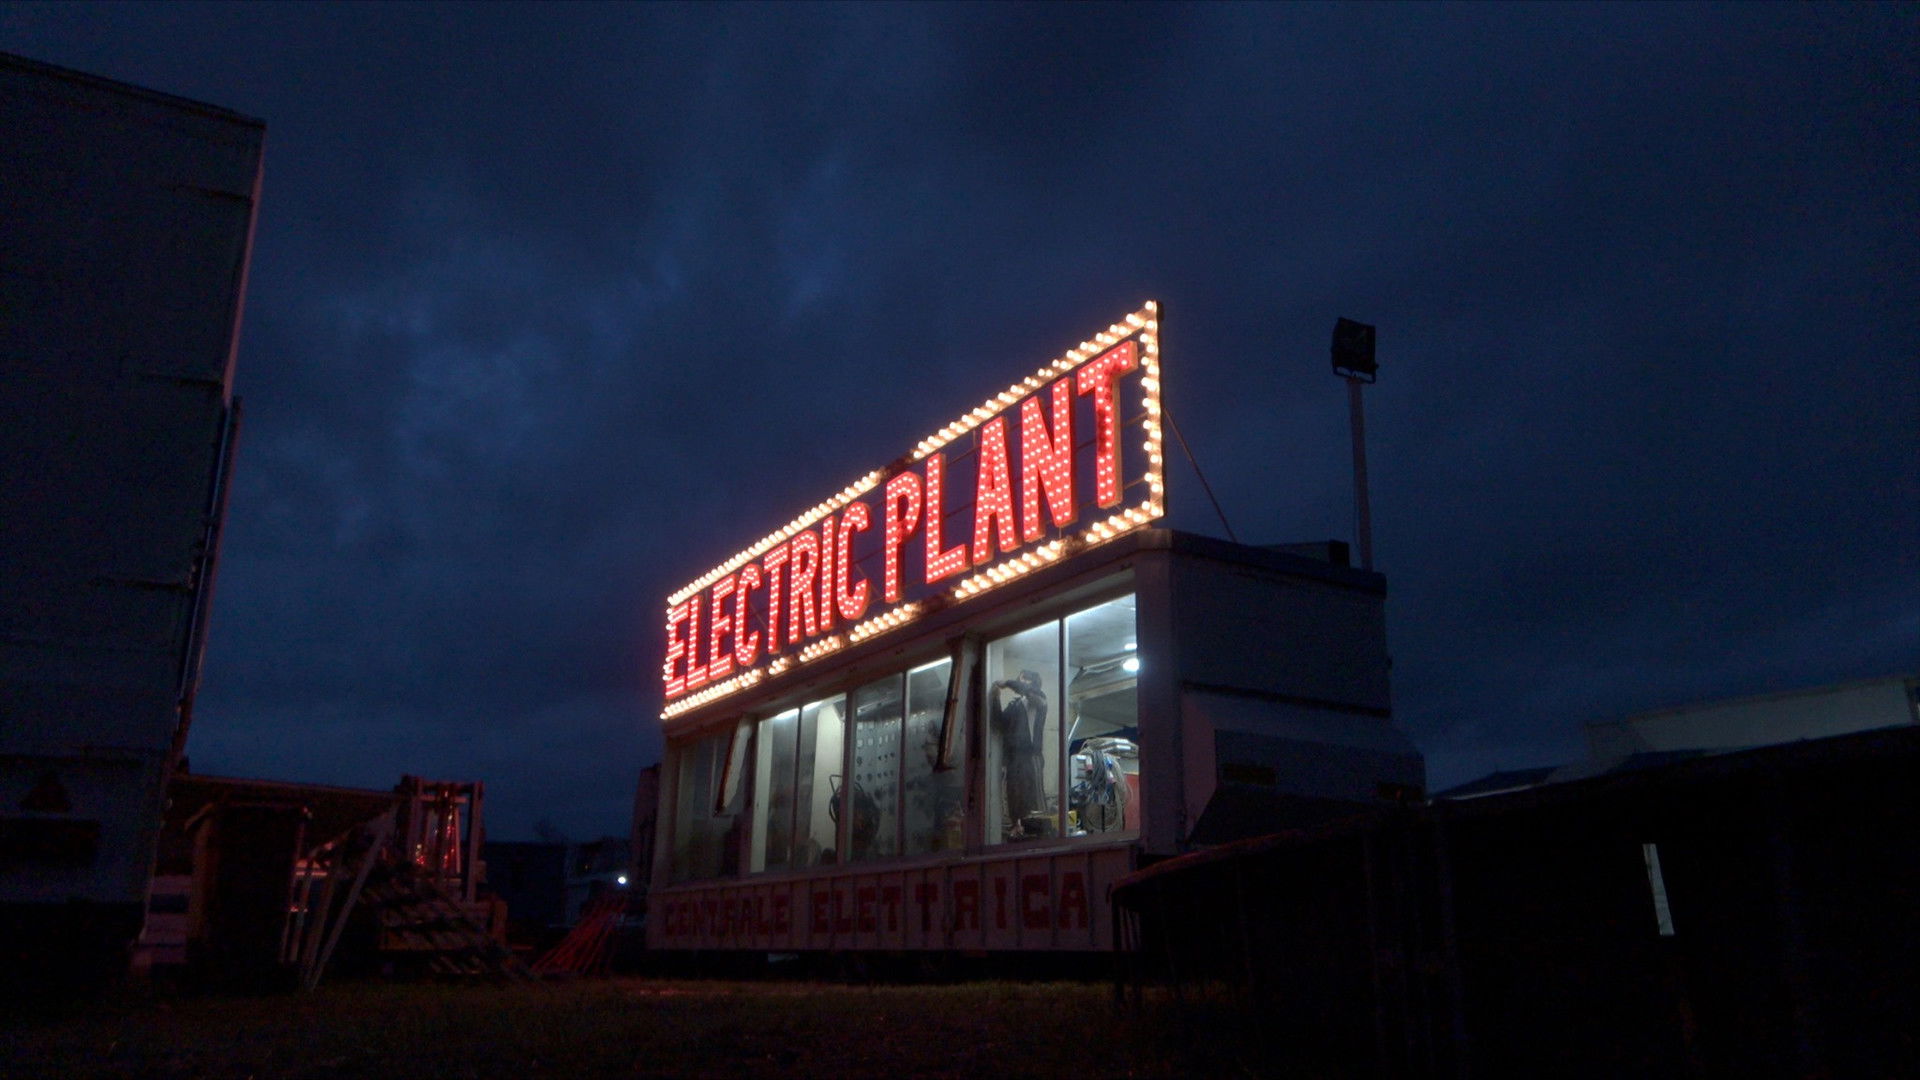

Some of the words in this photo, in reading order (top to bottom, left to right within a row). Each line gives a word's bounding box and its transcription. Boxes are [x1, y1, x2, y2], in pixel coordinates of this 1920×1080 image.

[665, 502, 870, 699] ELECTRIC
[885, 341, 1138, 603] PLANT
[664, 894, 789, 936] CENTRALE
[812, 872, 1089, 933] ELETTRICA
